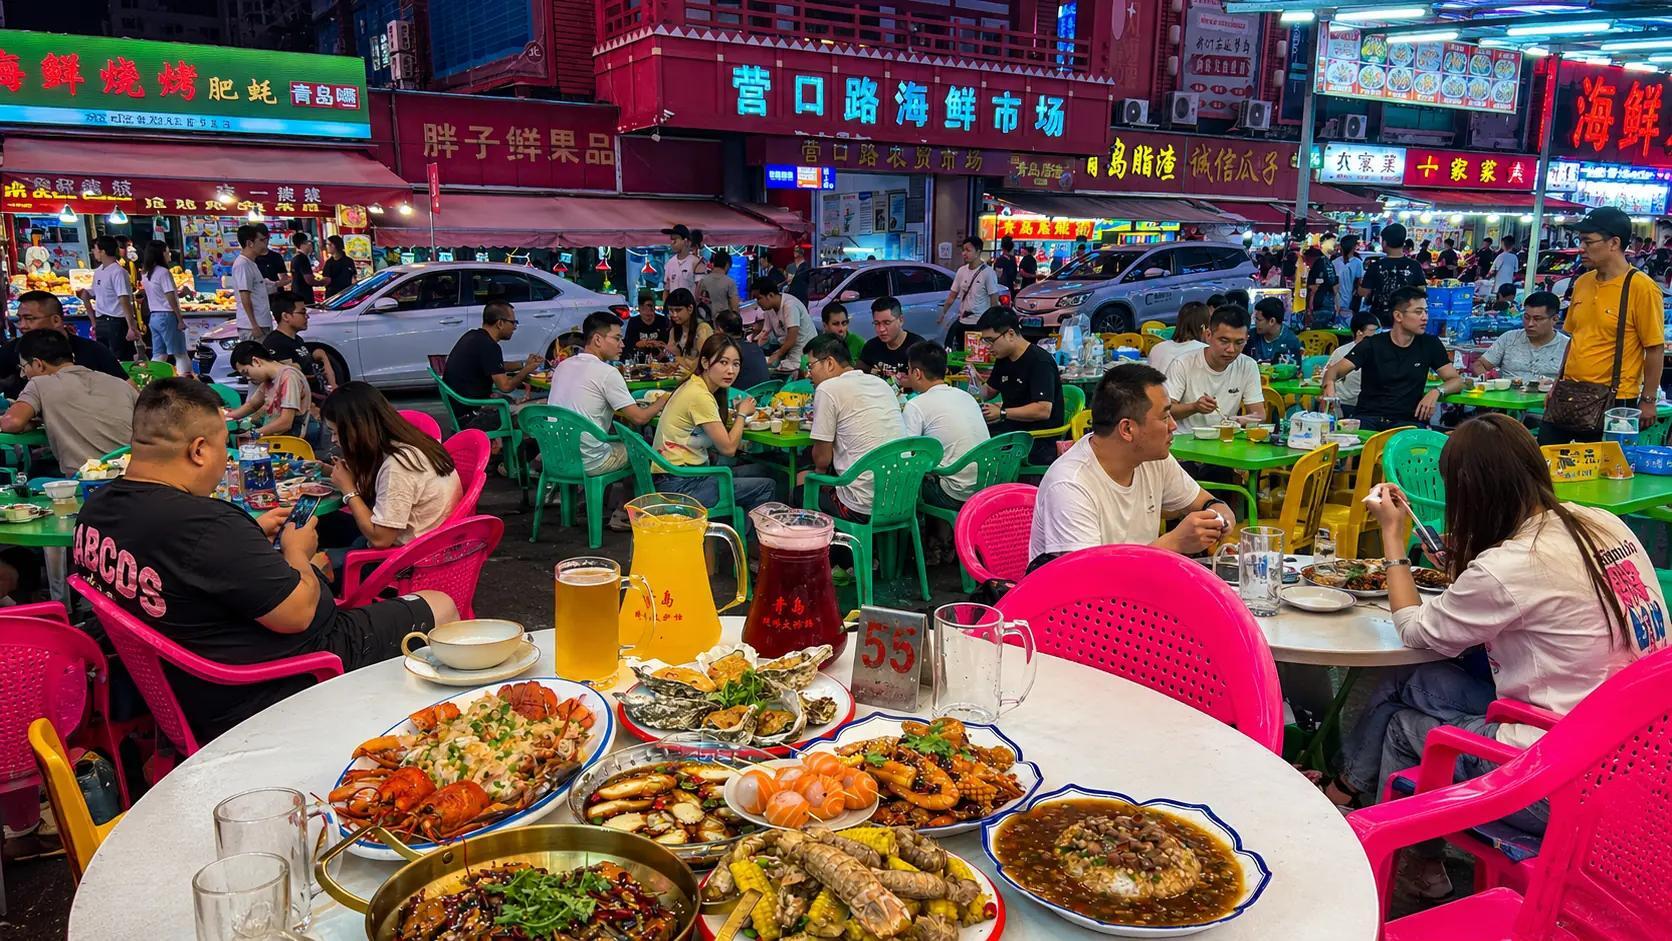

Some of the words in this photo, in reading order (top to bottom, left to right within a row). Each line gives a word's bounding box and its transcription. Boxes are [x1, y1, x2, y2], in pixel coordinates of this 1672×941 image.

[732, 64, 1066, 137] 营口路海鲜市场
[1573, 76, 1672, 158] 海鲜
[423, 122, 614, 165] 胖子鲜果品
[801, 140, 983, 172] 营口路农贸市场
[861, 620, 917, 674] 55
